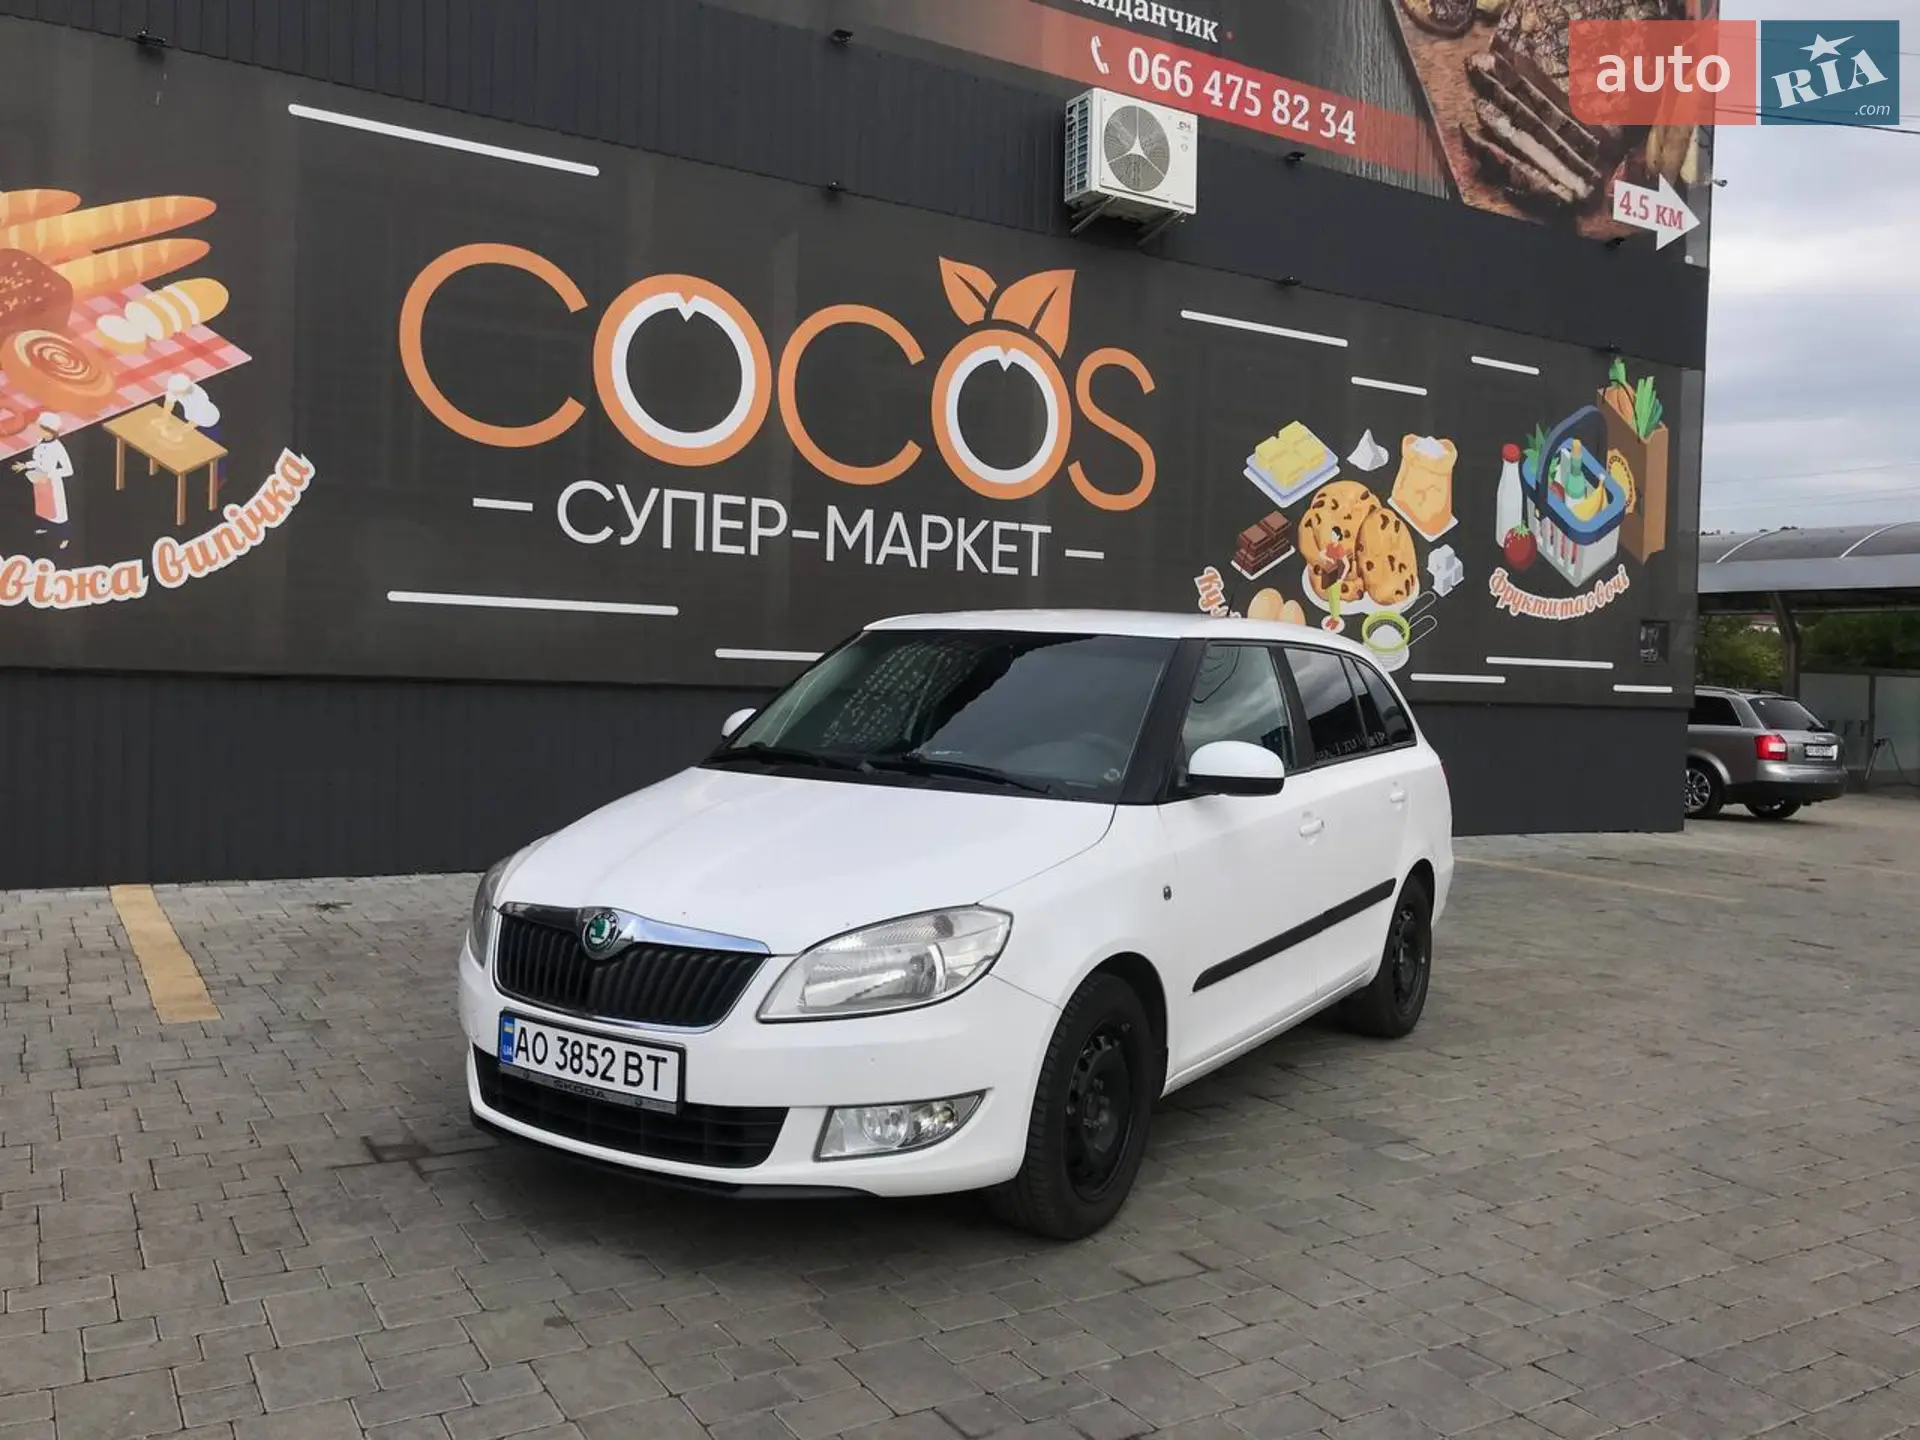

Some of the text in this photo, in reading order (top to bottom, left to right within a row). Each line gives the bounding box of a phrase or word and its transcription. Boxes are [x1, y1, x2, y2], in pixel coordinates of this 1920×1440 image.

[1127, 46, 1357, 145] 066 475 82 34
[1618, 190, 1650, 221] 4.5
[400, 243, 1157, 511] COCOS
[154, 449, 315, 588] випічка
[515, 1026, 668, 1092] AO 3852 BT
